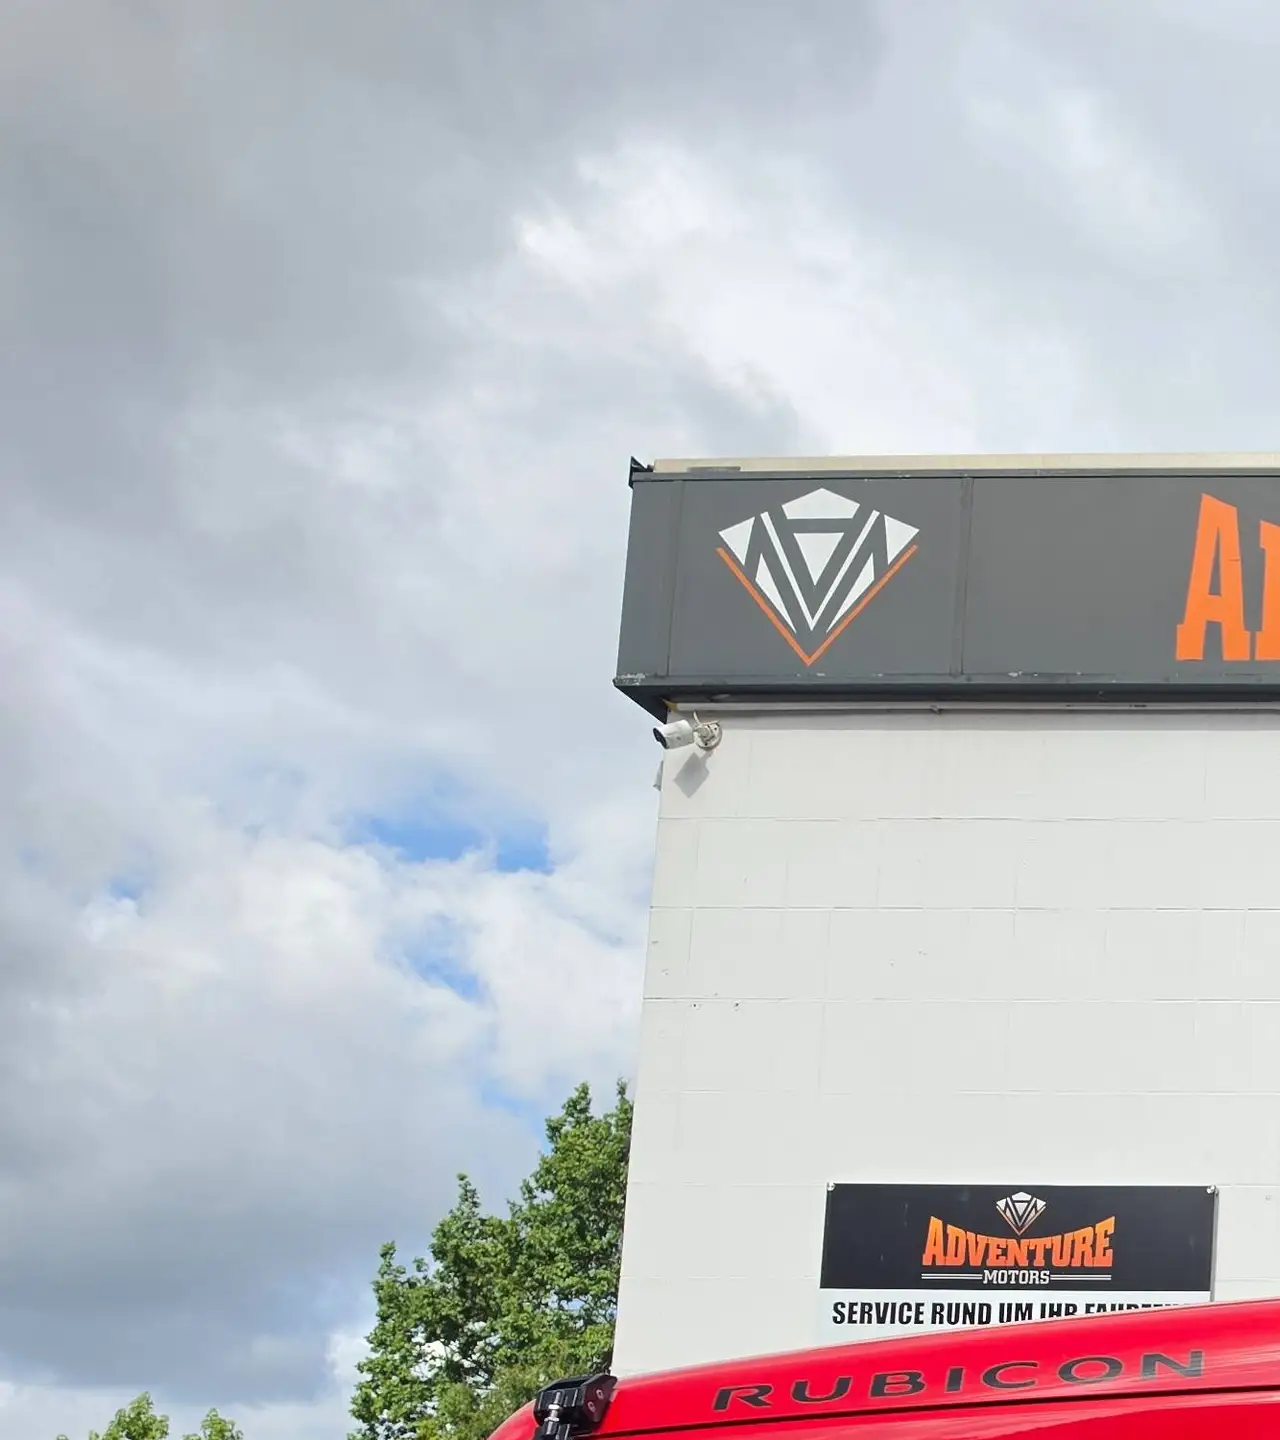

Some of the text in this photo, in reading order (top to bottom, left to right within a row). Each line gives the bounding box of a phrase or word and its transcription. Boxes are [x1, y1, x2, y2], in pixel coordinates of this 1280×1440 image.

[922, 1215, 1116, 1268] ADVENTURE
[982, 1269, 1050, 1285] MOTORS
[832, 1301, 924, 1326] SERVICE
[931, 1302, 992, 1326] RUND
[1000, 1302, 1033, 1324] UM
[713, 1350, 1204, 1411] RUBICON
